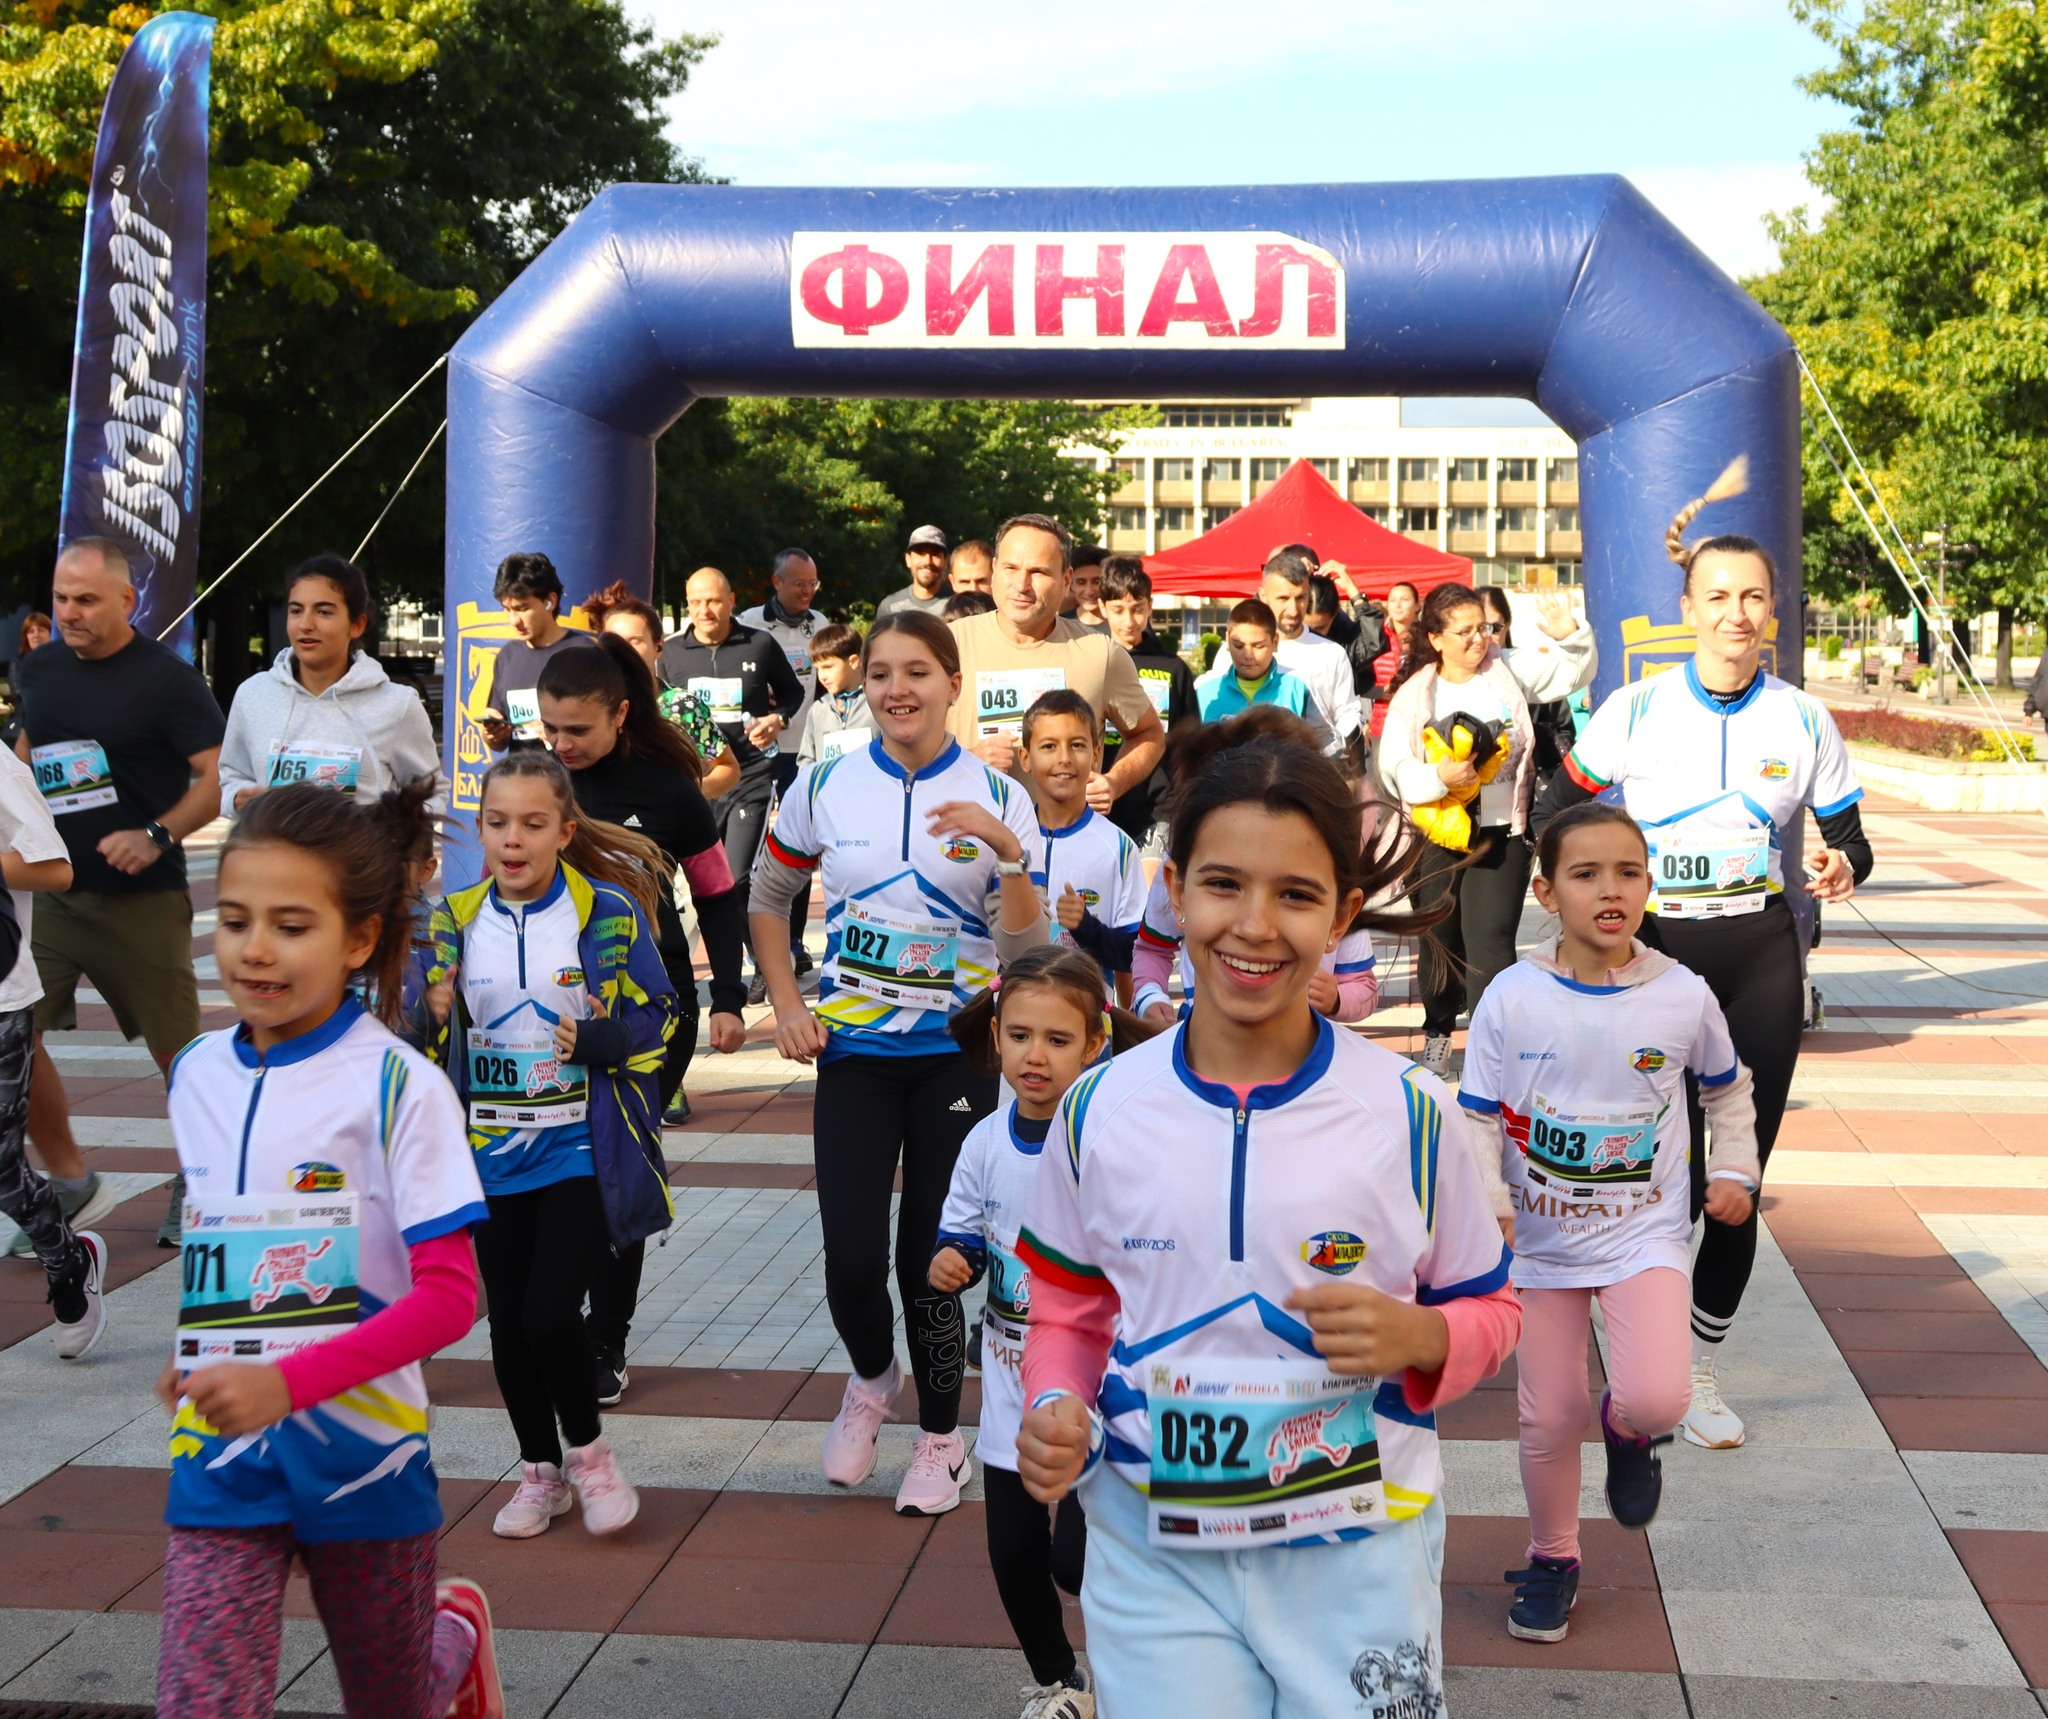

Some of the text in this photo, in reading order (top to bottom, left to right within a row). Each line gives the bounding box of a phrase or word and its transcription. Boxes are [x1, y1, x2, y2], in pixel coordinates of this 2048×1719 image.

[800, 244, 1337, 338] ФИНАЛ
[179, 297, 200, 513] energy drink
[981, 688, 1018, 710] 043
[36, 761, 65, 786] 068
[271, 759, 307, 781] 065
[1662, 854, 1710, 881] 030
[889, 920, 912, 930] PREDELA
[846, 924, 890, 961] 027
[474, 1055, 518, 1087] 026
[949, 1104, 972, 1112] adidas
[1534, 1118, 1587, 1161] 093
[1508, 1181, 1663, 1218] EMIRAS
[1558, 1223, 1611, 1234] WEALTH
[1131, 1238, 1176, 1251] BRYZOS
[184, 1242, 226, 1294] 071
[1173, 1373, 1190, 1395] A1
[1234, 1382, 1280, 1394] PREDELA
[1160, 1410, 1250, 1468] 032
